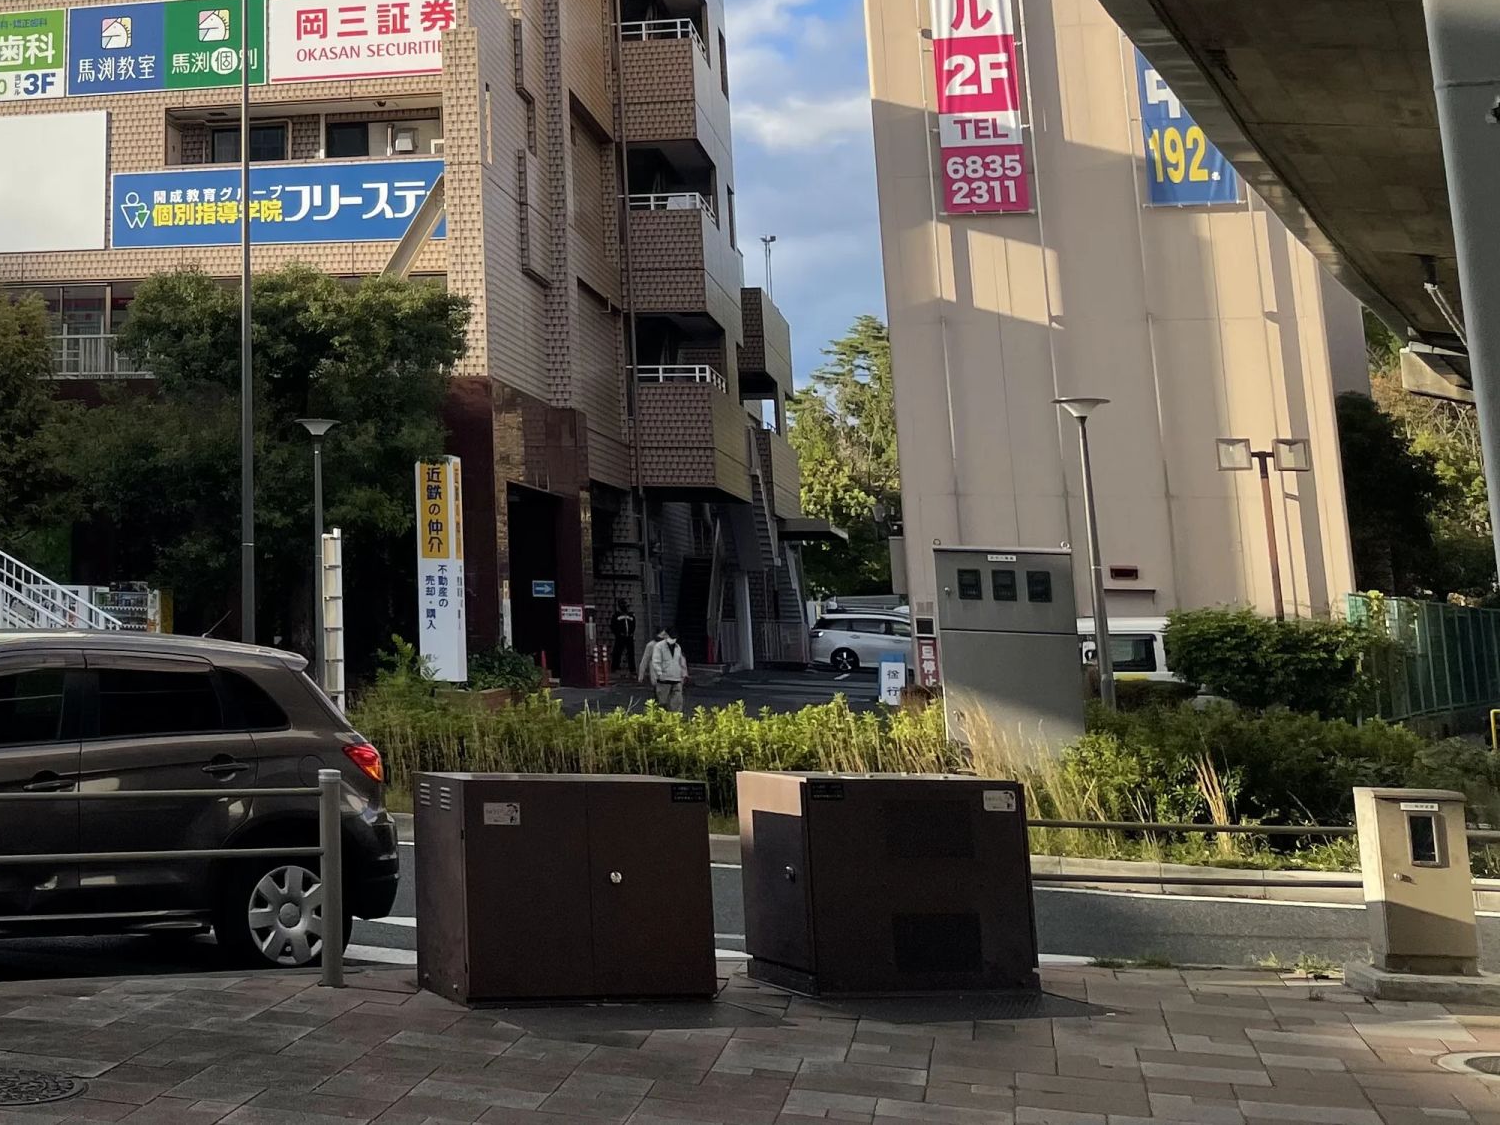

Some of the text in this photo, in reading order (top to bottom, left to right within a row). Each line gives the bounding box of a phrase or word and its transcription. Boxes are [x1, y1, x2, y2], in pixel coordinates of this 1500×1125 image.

[296, 0, 456, 42] 岡三証券
[296, 45, 361, 63] OKASAN
[23, 72, 57, 95] 3F
[943, 52, 1009, 97] 2F
[953, 118, 1009, 141] TEL
[946, 154, 1023, 179] 6835
[951, 180, 1017, 204] 2311
[152, 199, 283, 227] 個別指導学院
[426, 467, 443, 553] 近鉄の仲介
[437, 564, 449, 608] 不動産の
